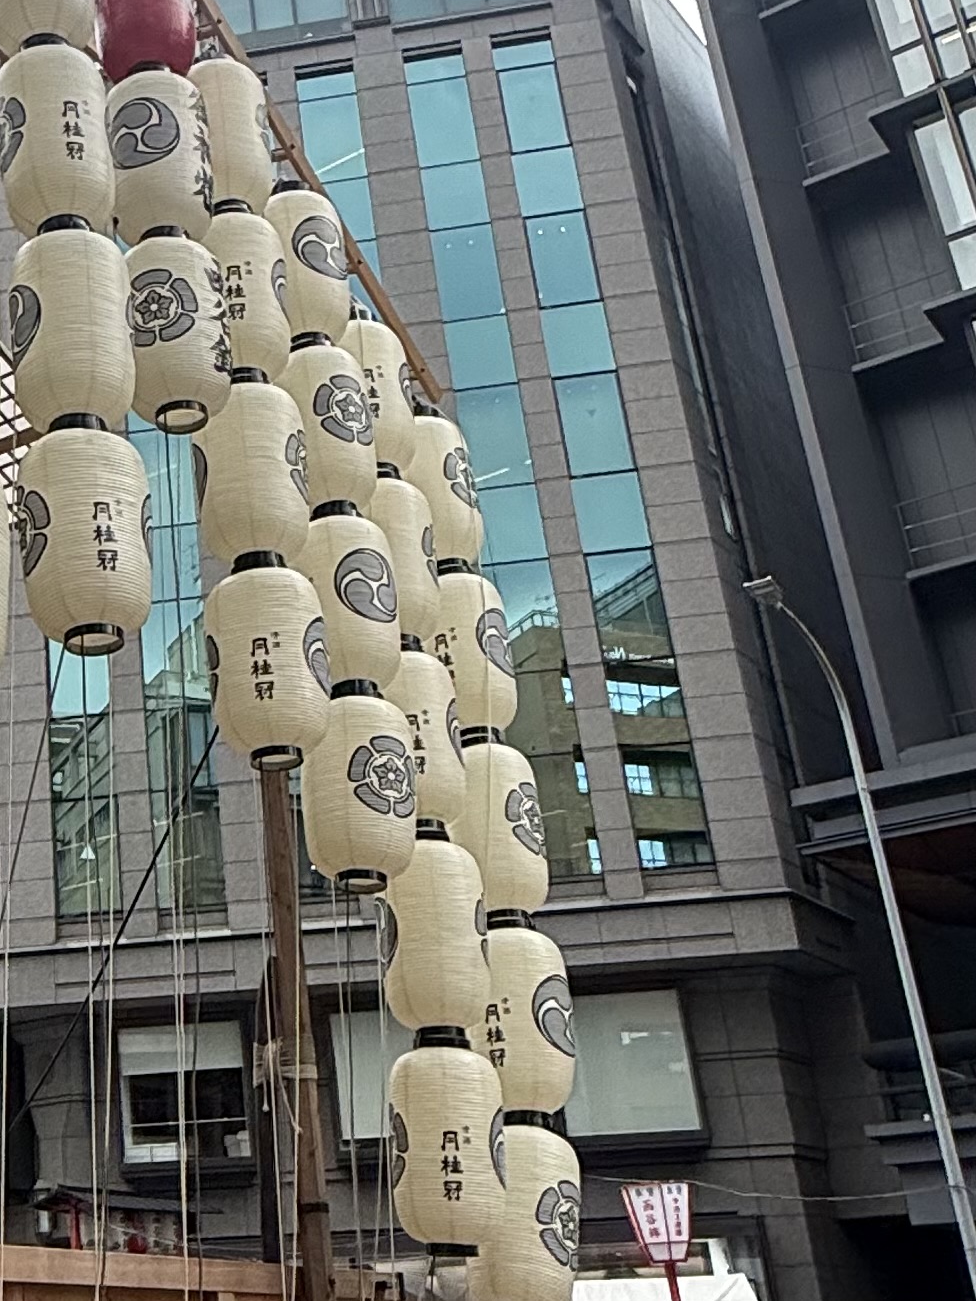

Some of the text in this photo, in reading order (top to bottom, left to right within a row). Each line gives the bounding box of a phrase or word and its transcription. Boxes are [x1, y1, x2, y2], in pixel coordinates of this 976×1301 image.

[61, 100, 85, 160] 月桂冠
[225, 265, 246, 320] 月桂冠
[92, 502, 119, 571] 月桂冠
[250, 637, 275, 701] 月桂冠
[485, 1003, 506, 1069] 月桂冠
[441, 1130, 464, 1201] 月桂冠
